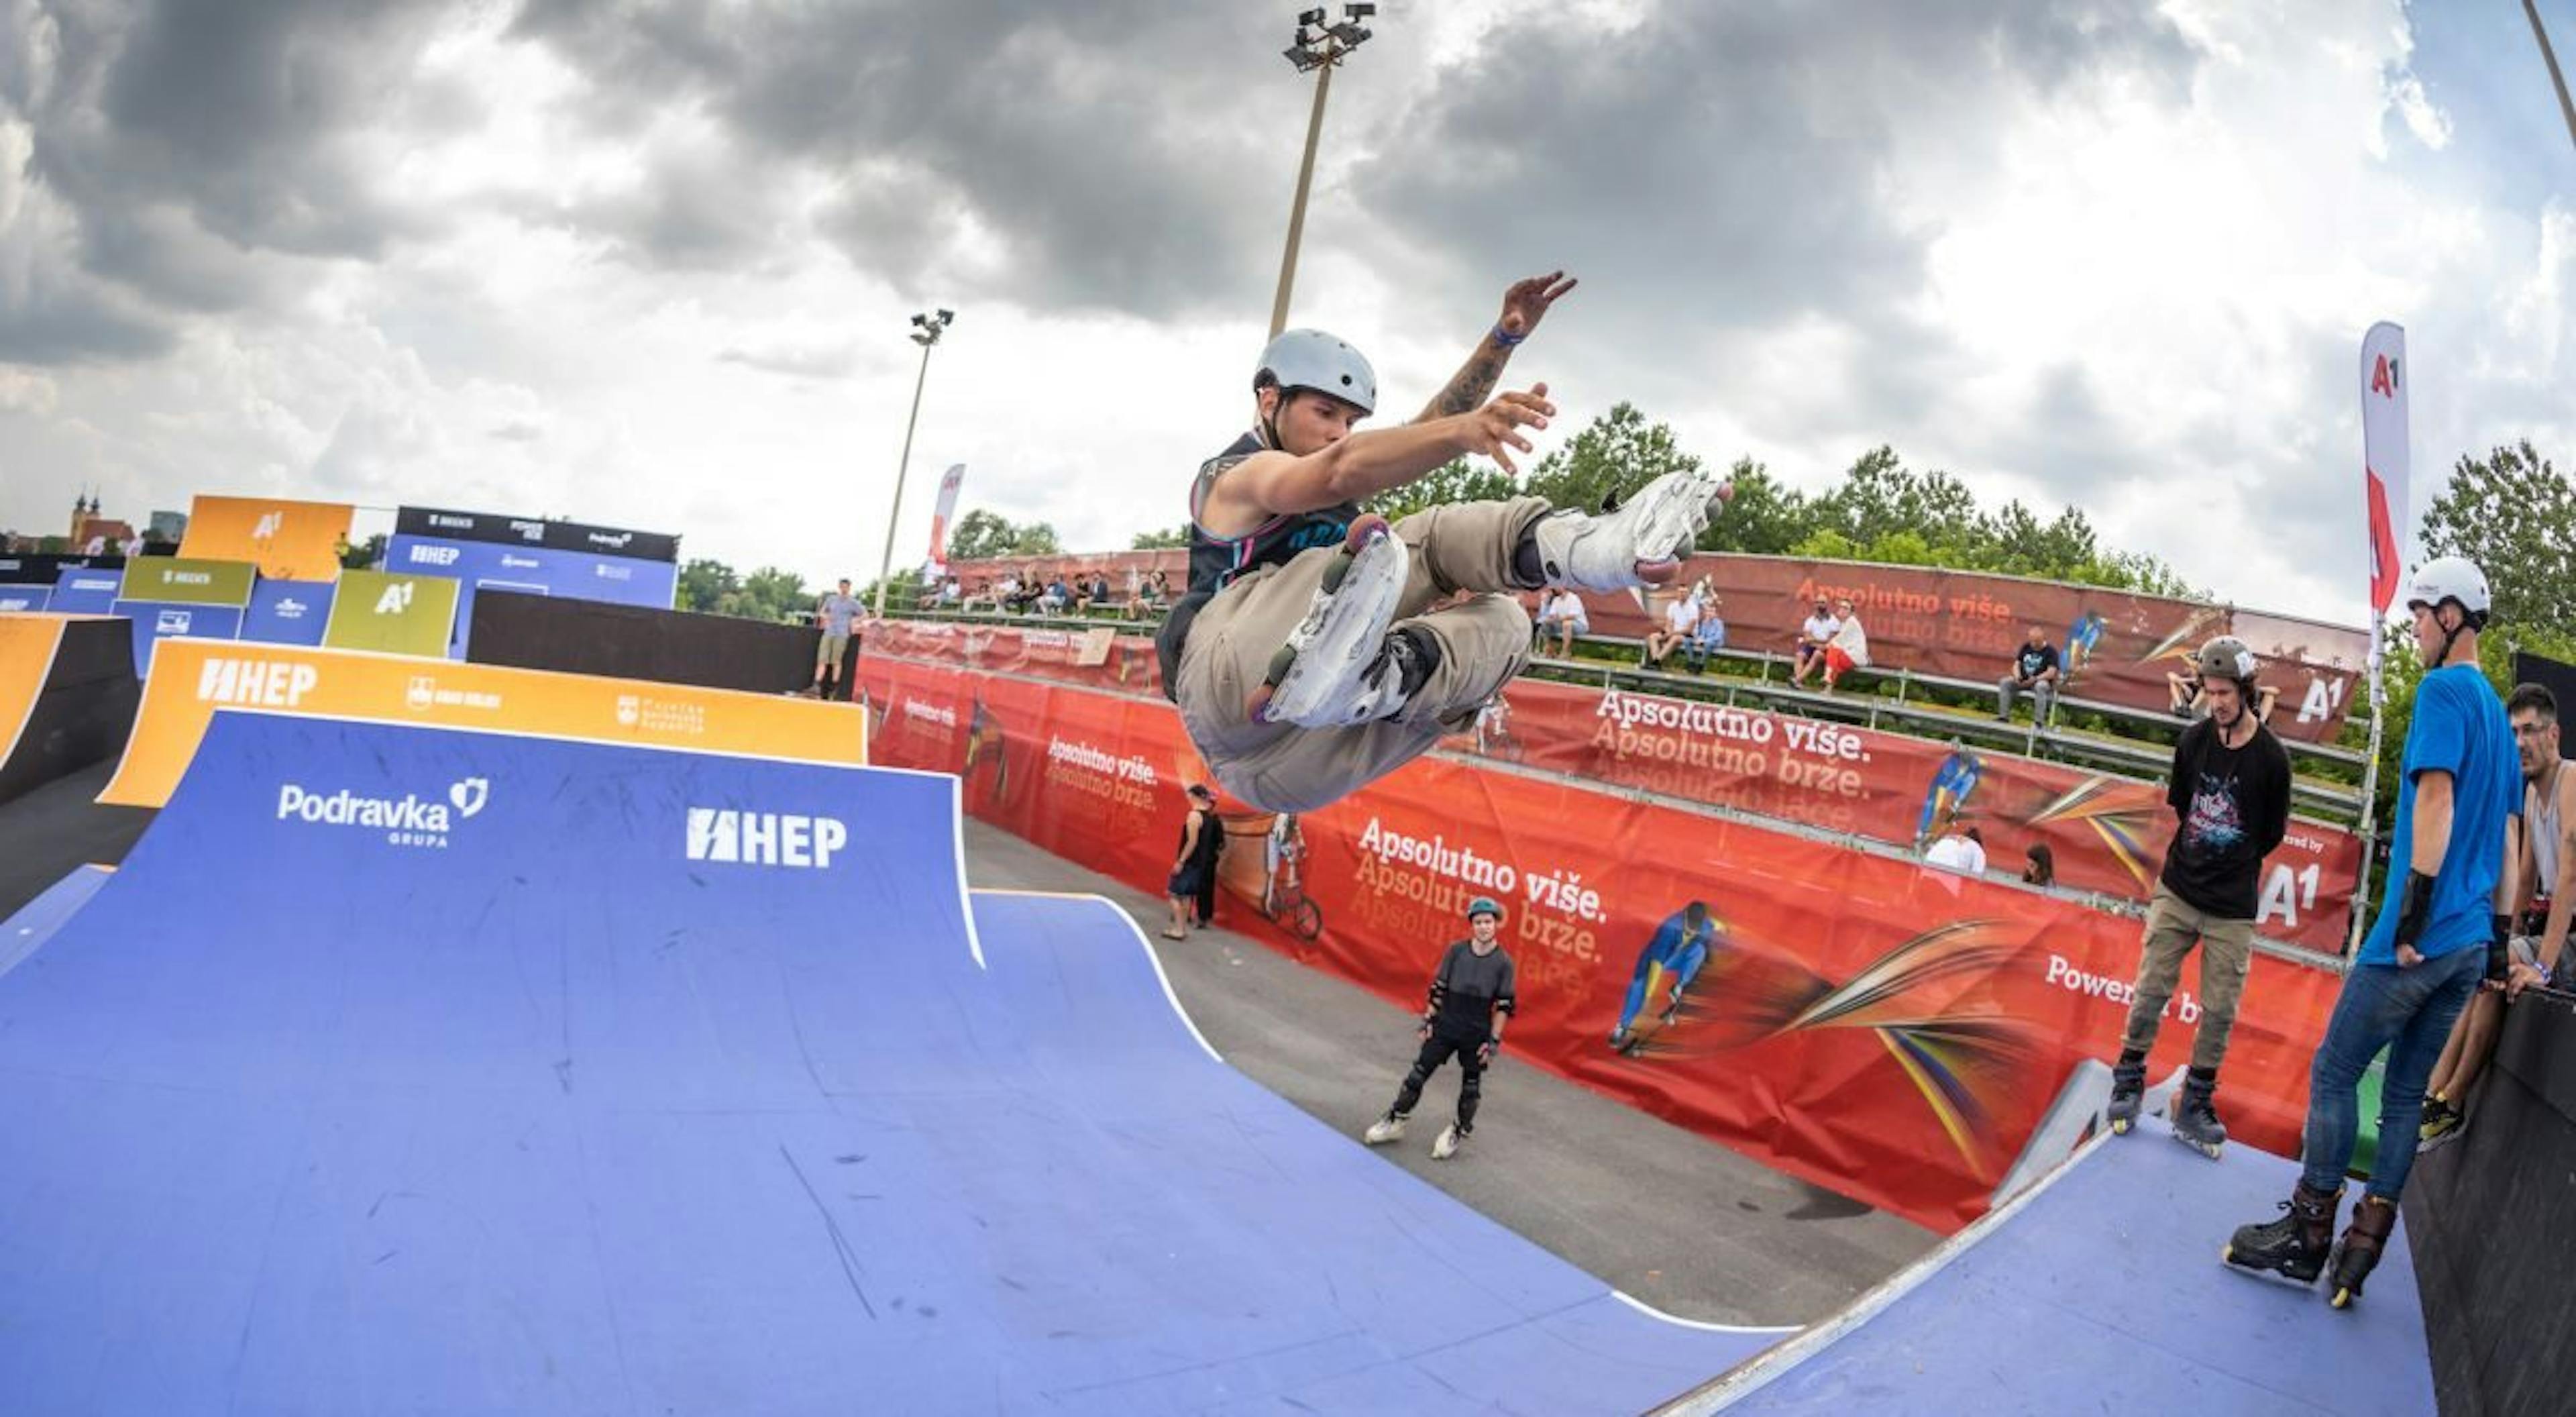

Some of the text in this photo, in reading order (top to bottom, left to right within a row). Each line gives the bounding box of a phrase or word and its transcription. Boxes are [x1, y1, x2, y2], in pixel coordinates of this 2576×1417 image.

[2371, 354, 2399, 399] A1
[252, 511, 282, 538] A1
[426, 546, 460, 566] HEP
[375, 581, 413, 614] A1
[234, 660, 317, 706] HEP
[2296, 677, 2344, 724] A1
[1597, 690, 1871, 762] Apsolutno više.
[1589, 718, 1870, 799] Apsolutno brže.
[278, 784, 449, 832] Podravka
[388, 831, 448, 849] GRUPA
[742, 811, 847, 869] HEP
[1358, 817, 1607, 924] Apsolutno više.
[2255, 863, 2320, 927] A1
[1518, 900, 1603, 963] brže.
[2045, 954, 2169, 1016] Power
